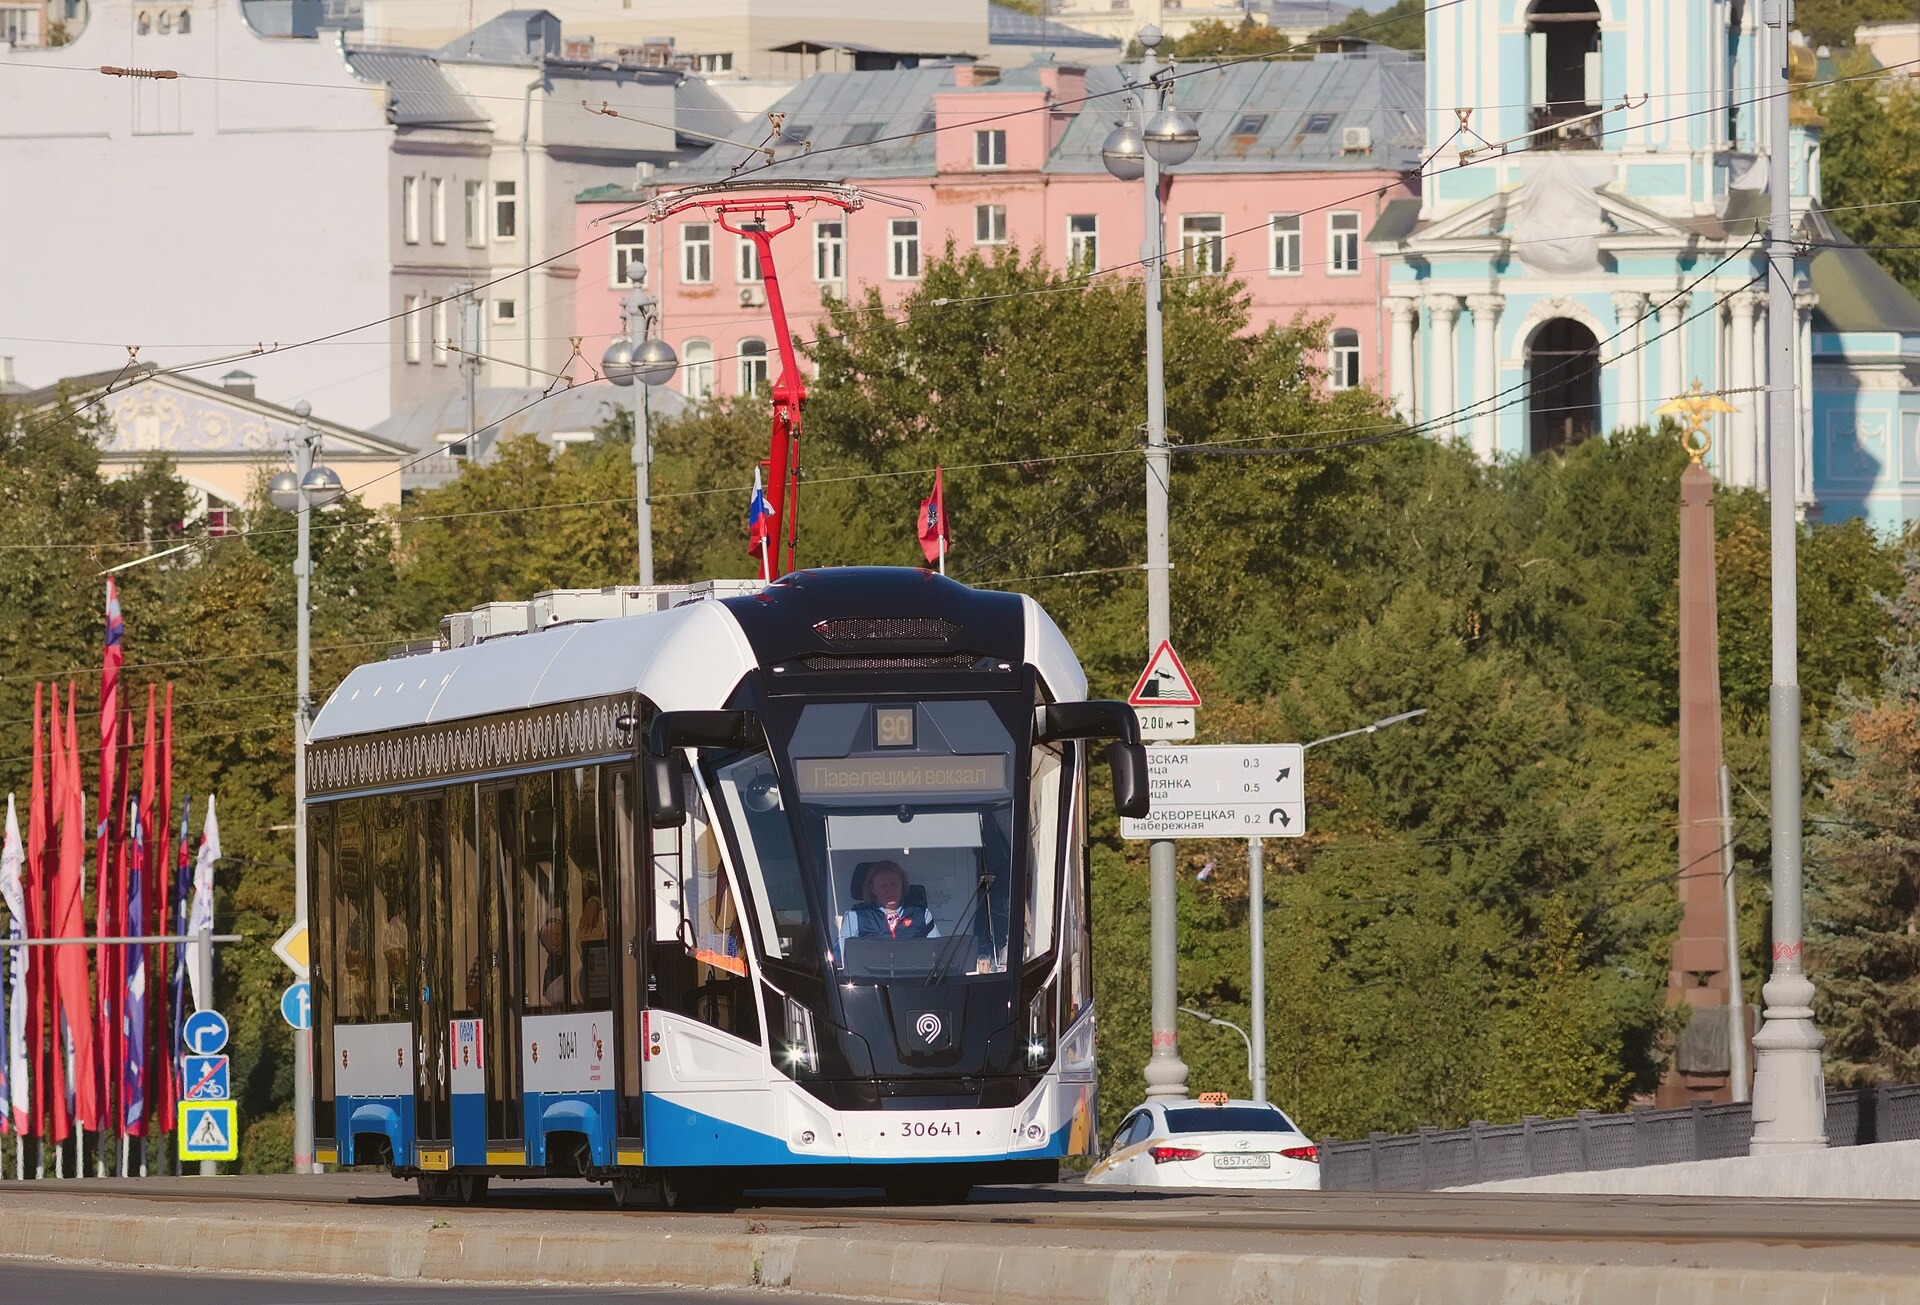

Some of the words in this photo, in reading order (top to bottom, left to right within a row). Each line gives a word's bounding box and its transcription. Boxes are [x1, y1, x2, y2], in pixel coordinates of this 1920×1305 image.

[880, 715, 908, 742] 90
[1243, 758, 1260, 768] 0.3
[814, 764, 923, 789] Павелецкий
[925, 768, 986, 785] вокзал
[1243, 783, 1260, 792] 0.5
[1134, 810, 1235, 822] ОСКВОРЕЦКАЯ
[1244, 815, 1261, 824] 0.2
[1133, 821, 1204, 832] набережная
[558, 1031, 577, 1060] 30641
[901, 1121, 961, 1137] 30641
